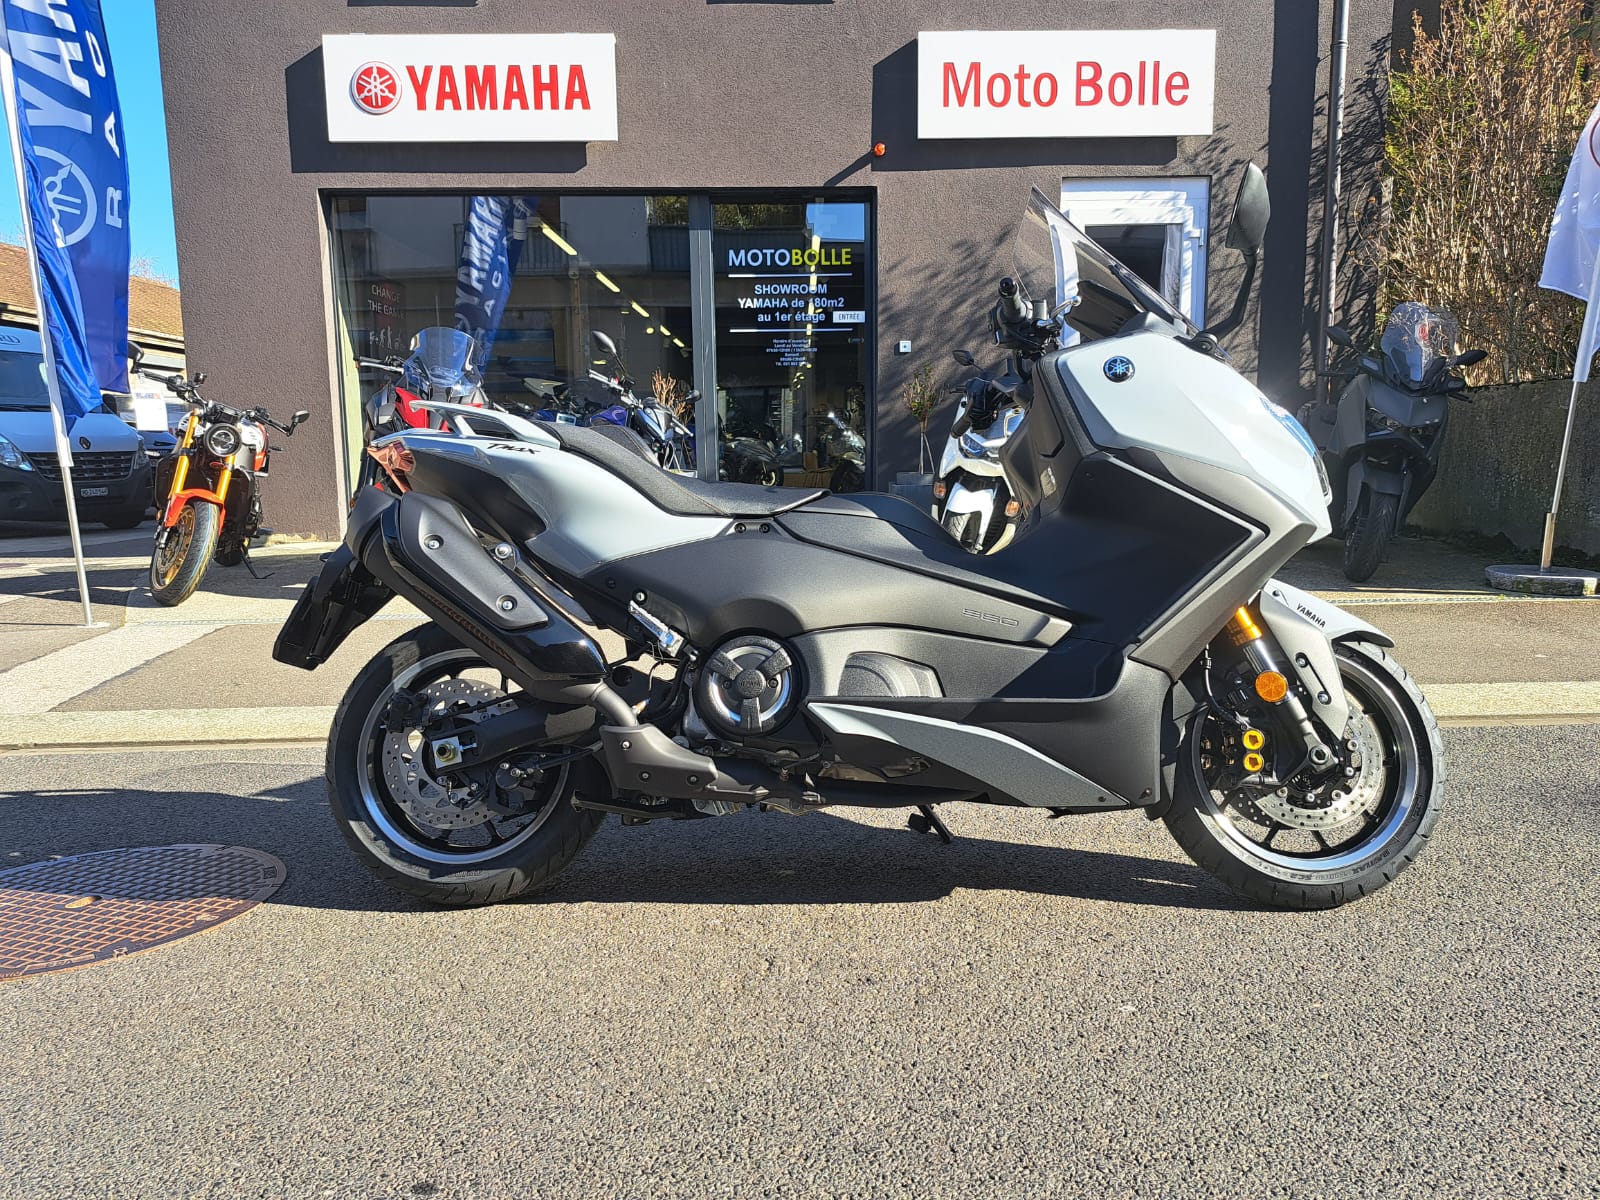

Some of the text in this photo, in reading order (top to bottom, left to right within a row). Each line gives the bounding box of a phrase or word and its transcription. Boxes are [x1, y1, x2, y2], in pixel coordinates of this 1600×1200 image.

[406, 64, 592, 111] YAMAHA
[942, 60, 1190, 108] Moto Bolle
[728, 248, 852, 267] MOTOBOLLE
[371, 284, 401, 304] CHANGE
[754, 284, 828, 295] SHOWROOM
[367, 299, 382, 314] THE
[738, 297, 789, 309] YAMAHA
[791, 297, 804, 307] de
[757, 311, 826, 324] au 1er étage
[1296, 603, 1327, 628] YAMAHA
